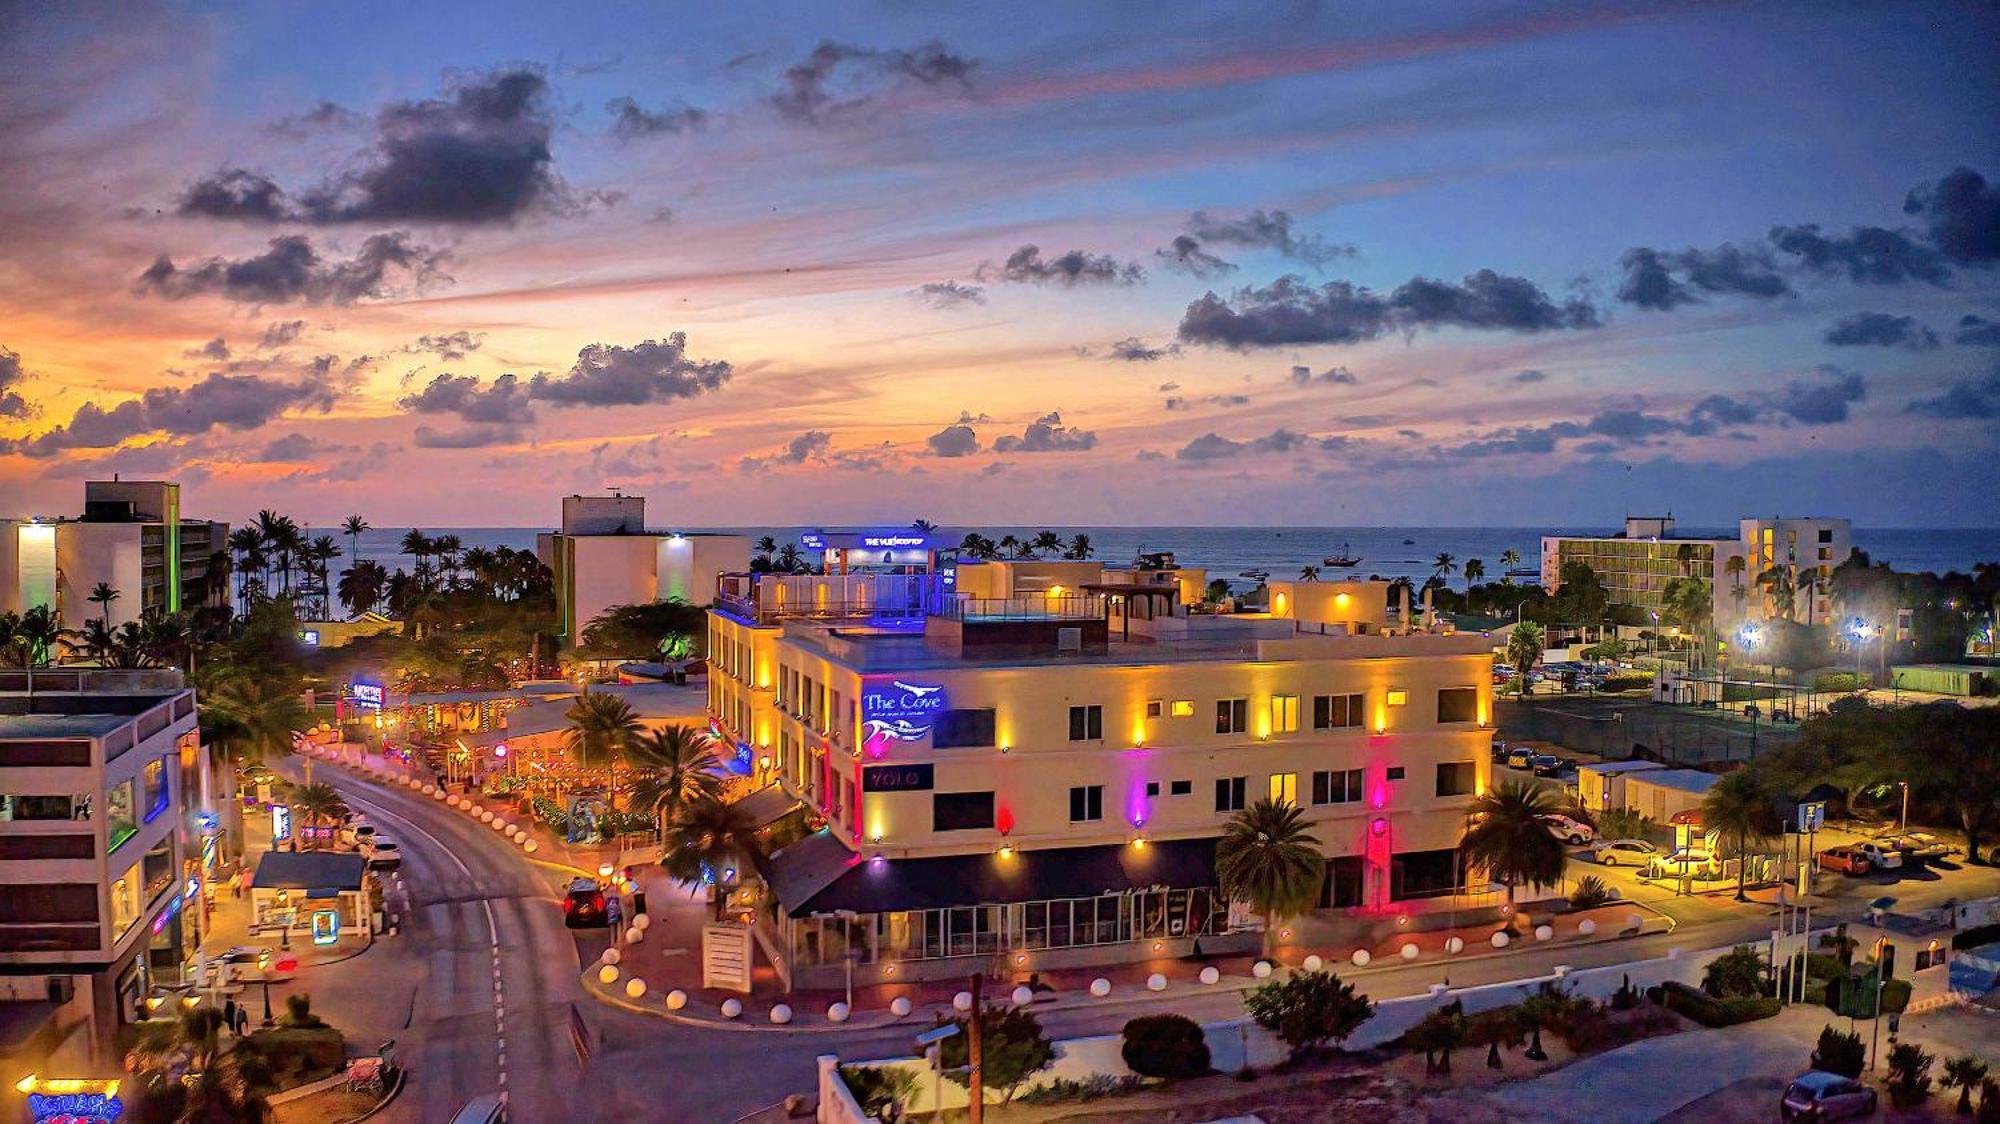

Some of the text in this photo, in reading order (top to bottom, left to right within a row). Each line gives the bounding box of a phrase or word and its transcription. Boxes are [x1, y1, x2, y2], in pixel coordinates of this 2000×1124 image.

[864, 538, 879, 546] THE
[862, 693, 941, 710] The Cove
